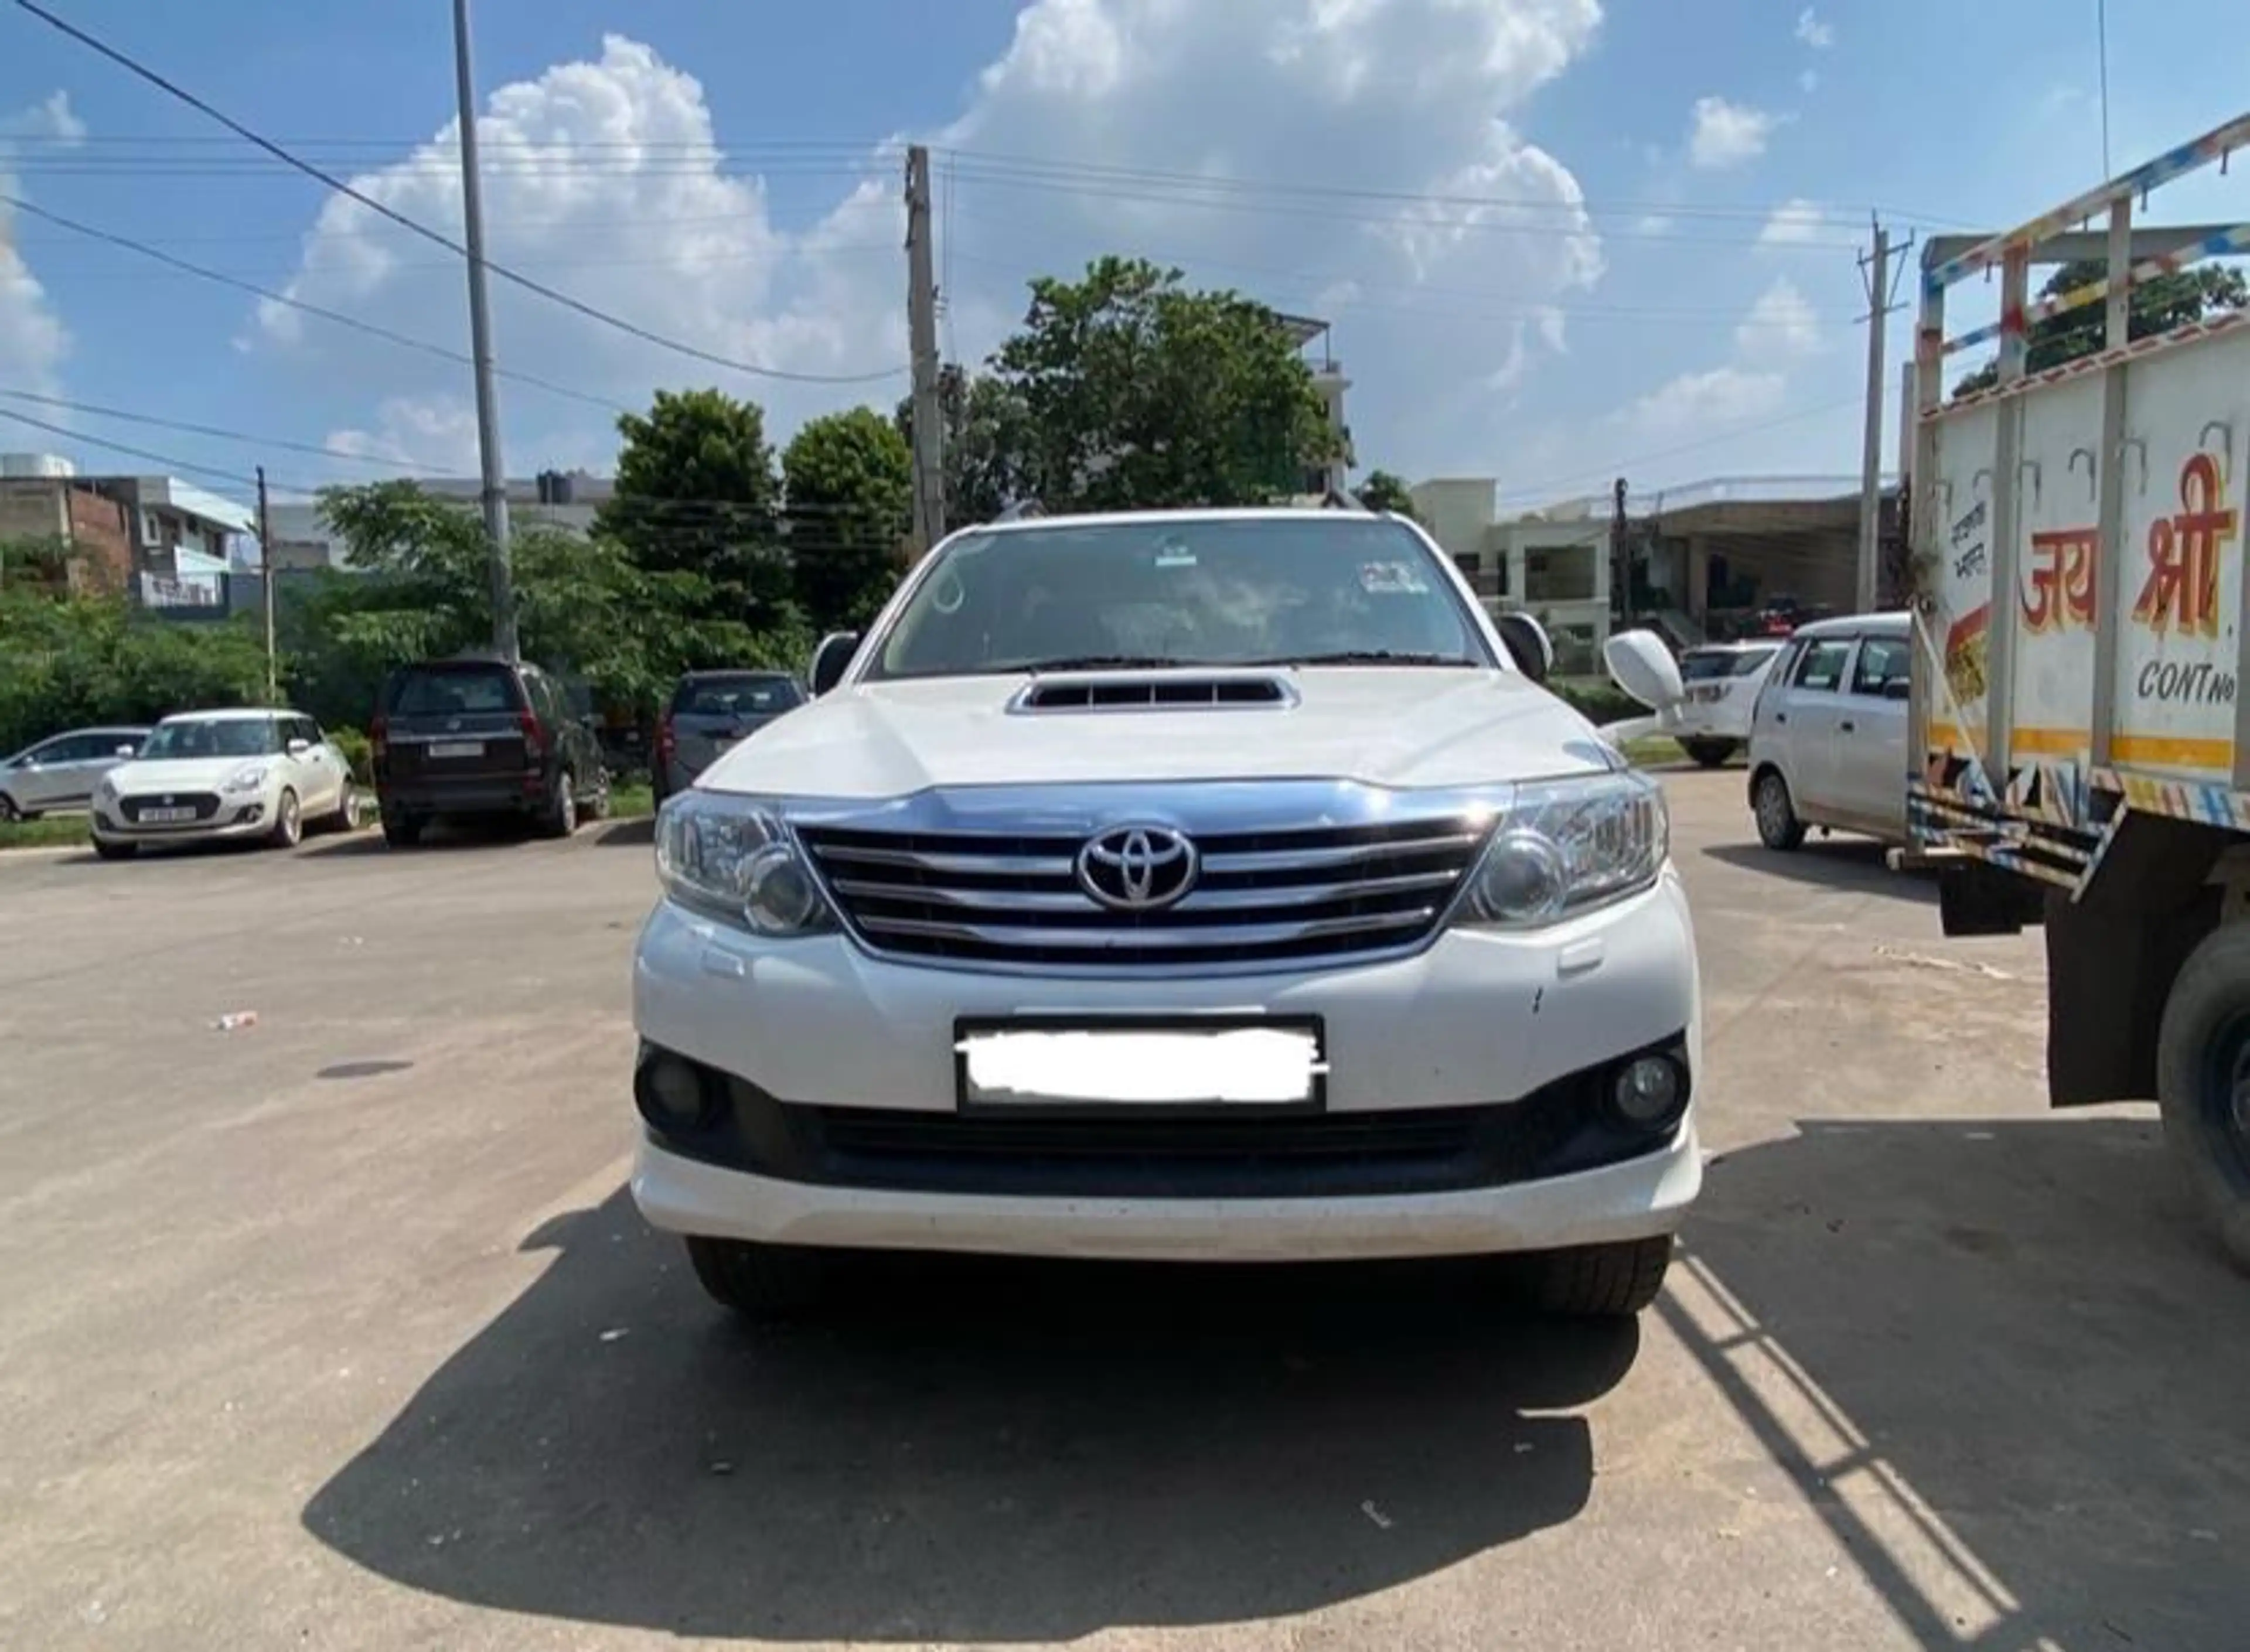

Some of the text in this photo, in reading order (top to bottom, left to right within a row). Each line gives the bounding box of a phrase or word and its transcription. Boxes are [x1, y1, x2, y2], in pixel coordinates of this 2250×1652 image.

[2020, 453, 2235, 634] जय श्री
[2138, 660, 2213, 702] CONT
